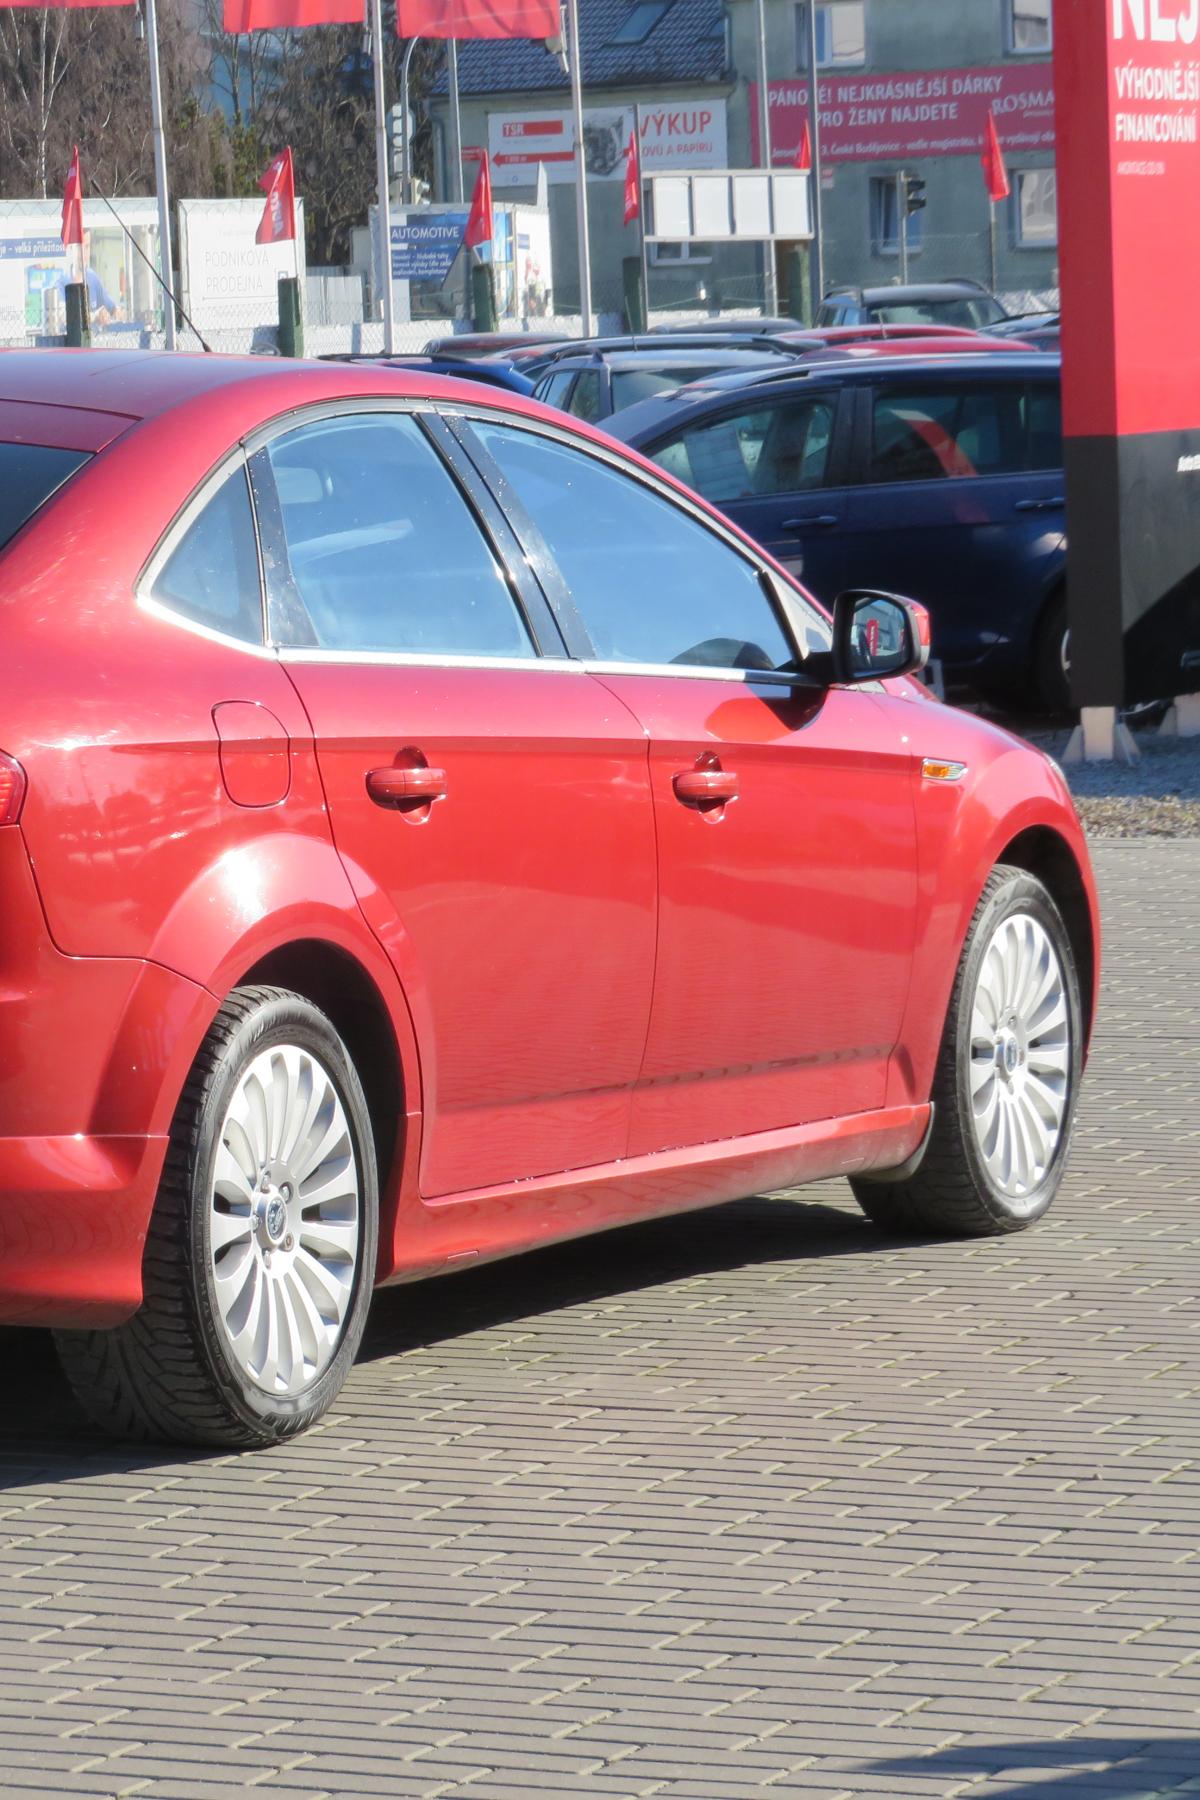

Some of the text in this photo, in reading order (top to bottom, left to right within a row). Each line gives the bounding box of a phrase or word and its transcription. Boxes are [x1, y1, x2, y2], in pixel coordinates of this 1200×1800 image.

[769, 74, 1003, 106] PÁNOÉ! NEJKRÁSNĚJŠÍ DÁRKY
[1115, 59, 1200, 100] VÝHODNĚJŠÍ
[992, 89, 1055, 115] ROSMA
[848, 106, 886, 126] ŽENY
[891, 102, 958, 123] NAJDETE
[503, 122, 525, 137] TSR
[1115, 108, 1197, 143] FINANCOVÁNÍ
[642, 144, 664, 157] OVŮ
[666, 144, 674, 156] A
[390, 226, 460, 240] AUTOMOTIVE
[15, 240, 32, 254] velká
[206, 275, 263, 293] PRODEJNA
